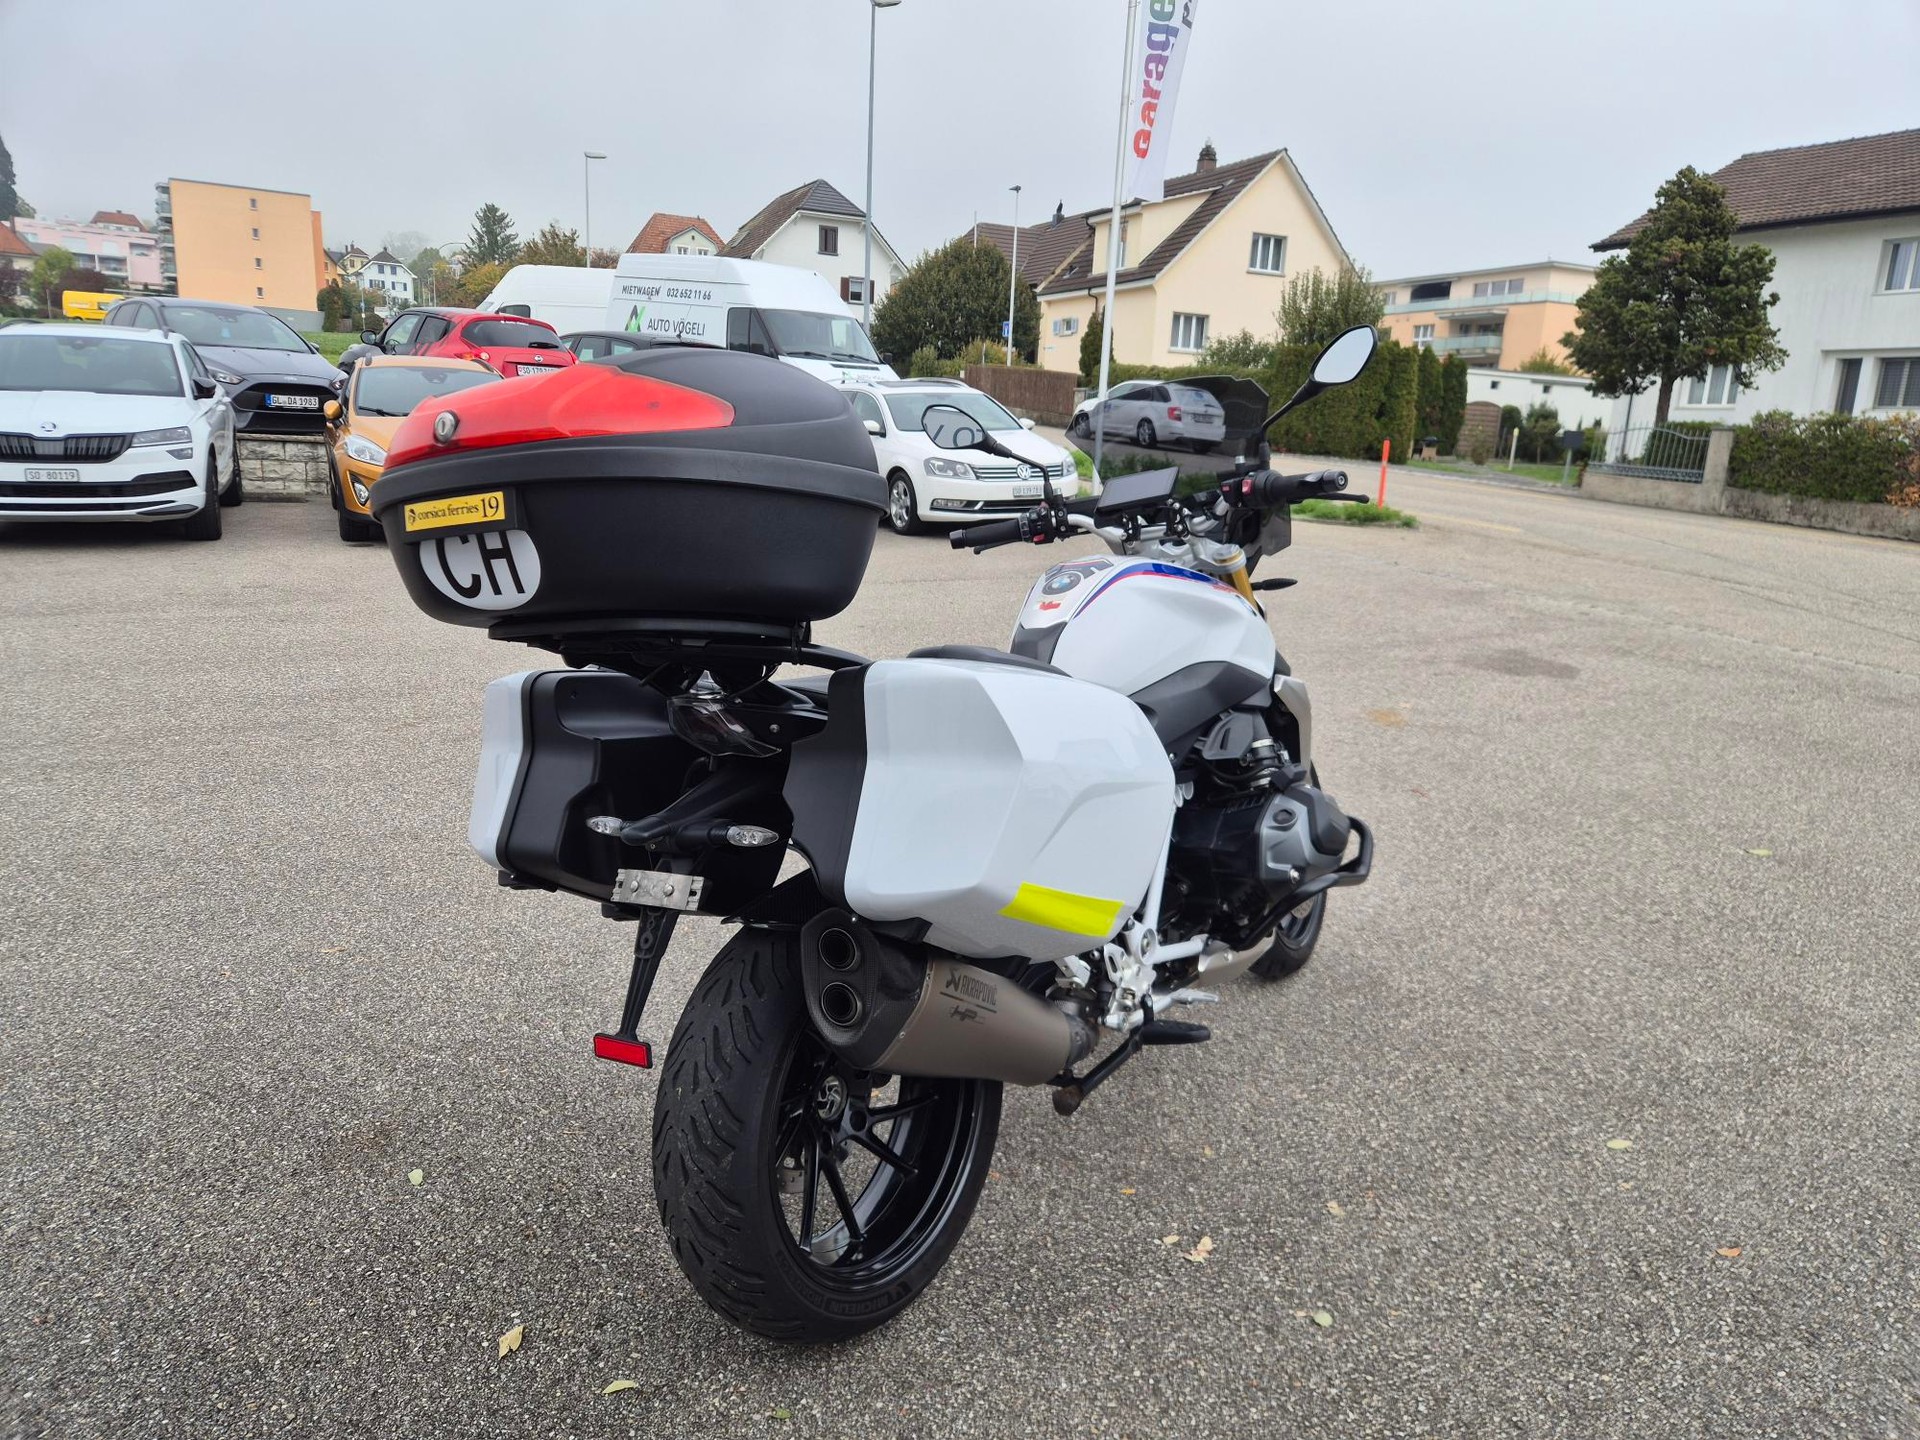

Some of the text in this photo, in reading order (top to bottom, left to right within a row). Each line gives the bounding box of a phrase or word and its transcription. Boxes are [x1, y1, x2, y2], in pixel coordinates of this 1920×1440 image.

[622, 285, 712, 301] MIETWAGEN 032 652 11 66
[647, 317, 706, 336] AUTO VÖGELI
[272, 396, 282, 405] GL
[299, 397, 318, 407] 1983
[46, 471, 75, 480] 80119
[418, 496, 499, 520] corsica ferries 19
[435, 531, 526, 599] CH
